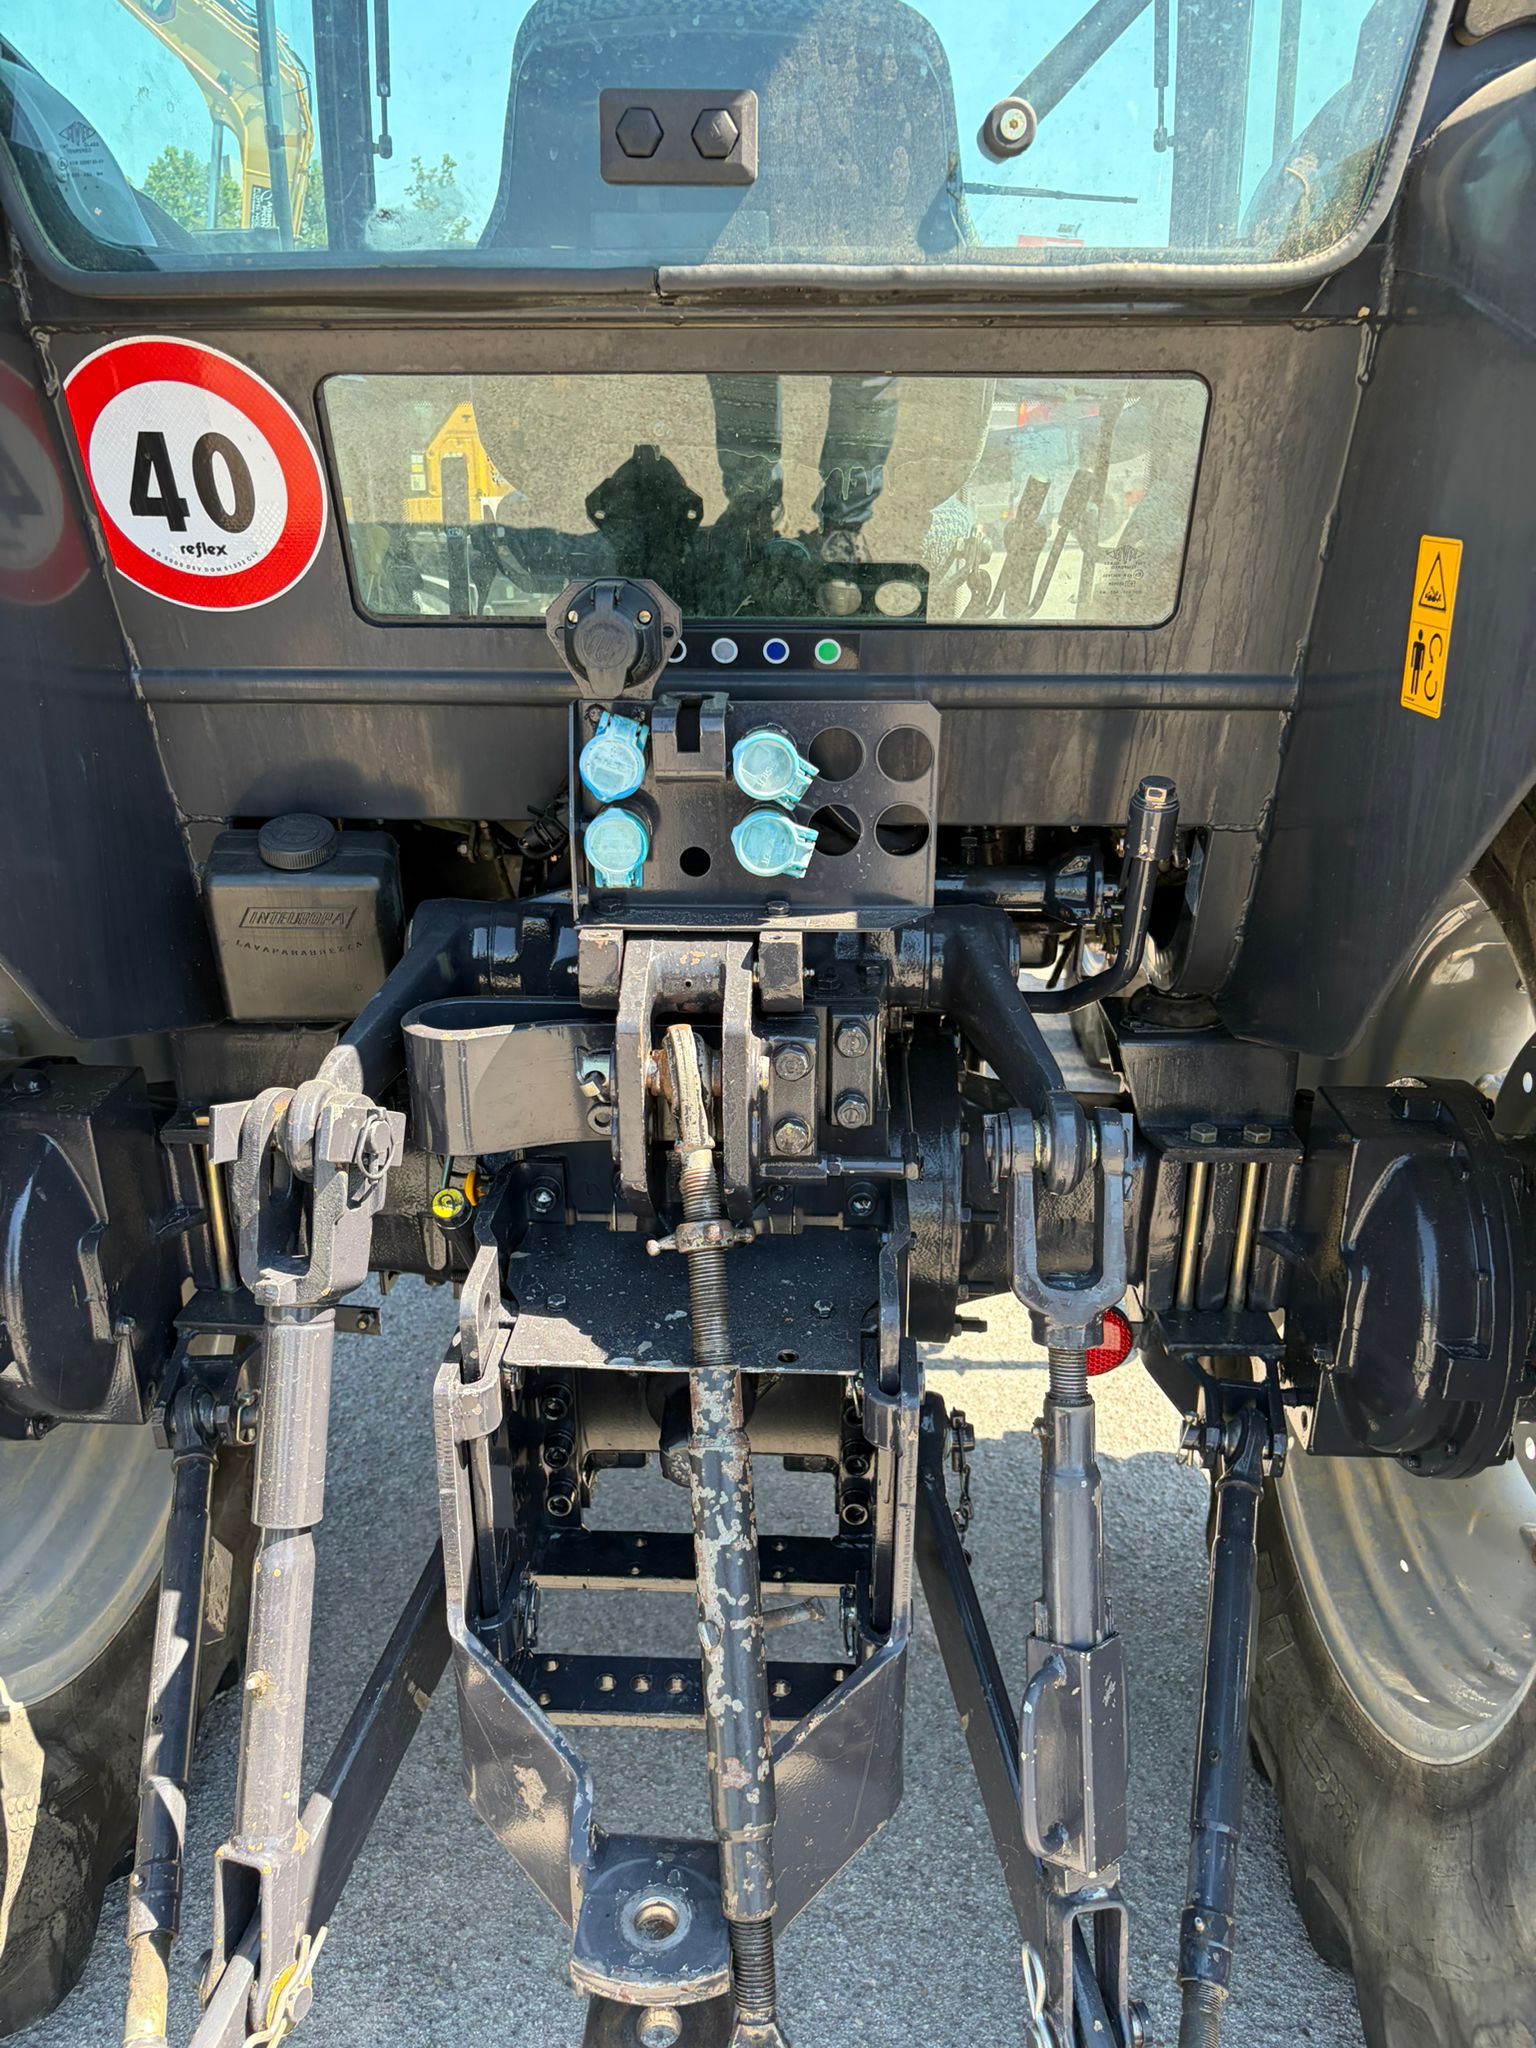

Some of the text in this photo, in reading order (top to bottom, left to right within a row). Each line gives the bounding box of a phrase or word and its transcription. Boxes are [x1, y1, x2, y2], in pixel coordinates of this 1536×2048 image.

[129, 430, 256, 534] 40
[180, 541, 228, 558] reflex
[248, 911, 345, 925] INTEUROPA
